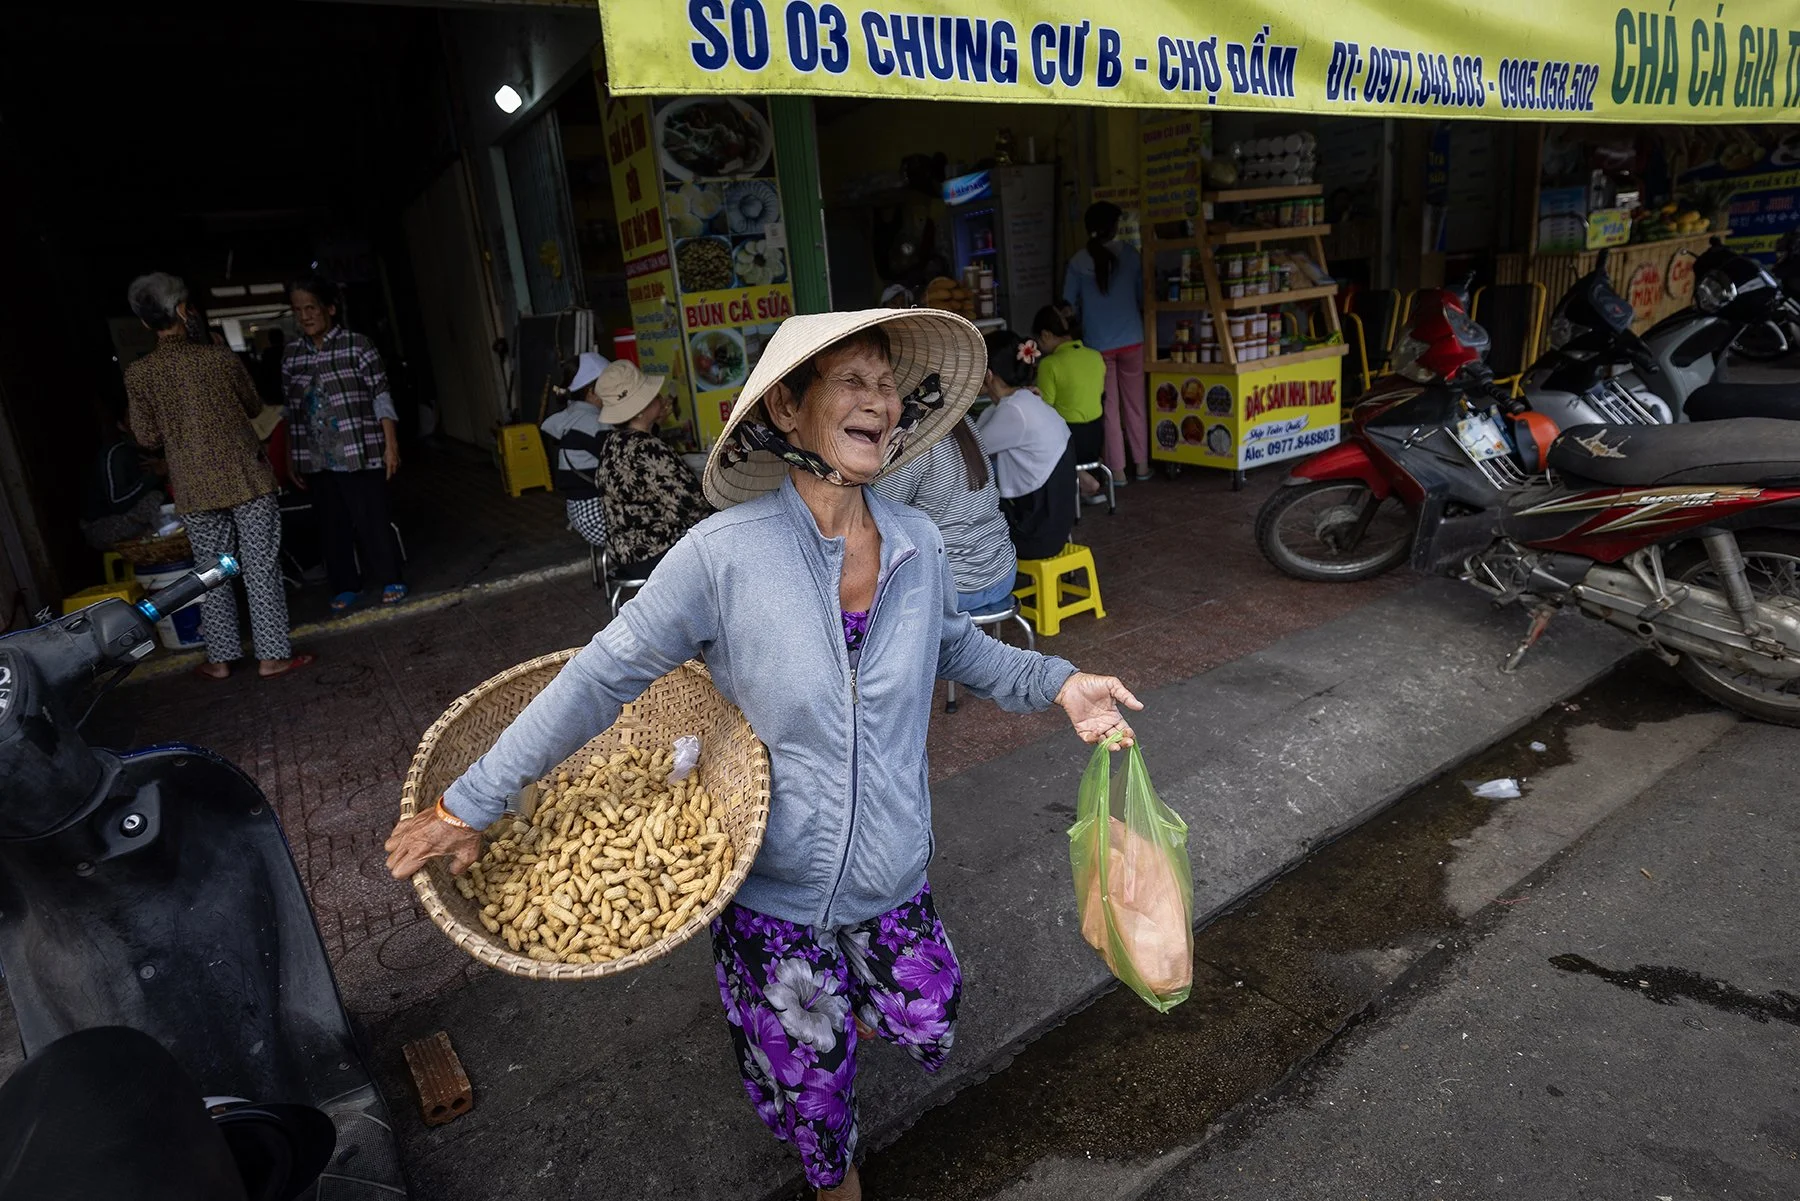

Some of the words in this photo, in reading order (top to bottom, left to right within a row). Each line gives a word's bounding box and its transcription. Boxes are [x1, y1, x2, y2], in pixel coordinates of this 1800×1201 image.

[786, 1, 849, 73] 03
[861, 12, 1018, 83] CHUNG
[1032, 21, 1090, 86] CƯ
[1098, 29, 1122, 88] B
[1158, 37, 1222, 104] CHỢ
[1226, 26, 1298, 97] ĐẦM
[1327, 42, 1363, 101] ĐT:
[1363, 47, 1486, 107] 0977.848.803
[1498, 59, 1600, 112] 0905.058.502
[1687, 4, 1728, 107] CÁ
[1734, 25, 1779, 108] GIA
[686, 297, 726, 328] BÚN
[729, 292, 753, 322] CÁ
[757, 288, 791, 319] SỨA
[1244, 384, 1265, 422] ĐẶC
[1266, 374, 1287, 412] SẢN
[1287, 380, 1308, 408] NHA
[1244, 445, 1265, 461] Alo:
[1267, 428, 1336, 457] 0977.848803
